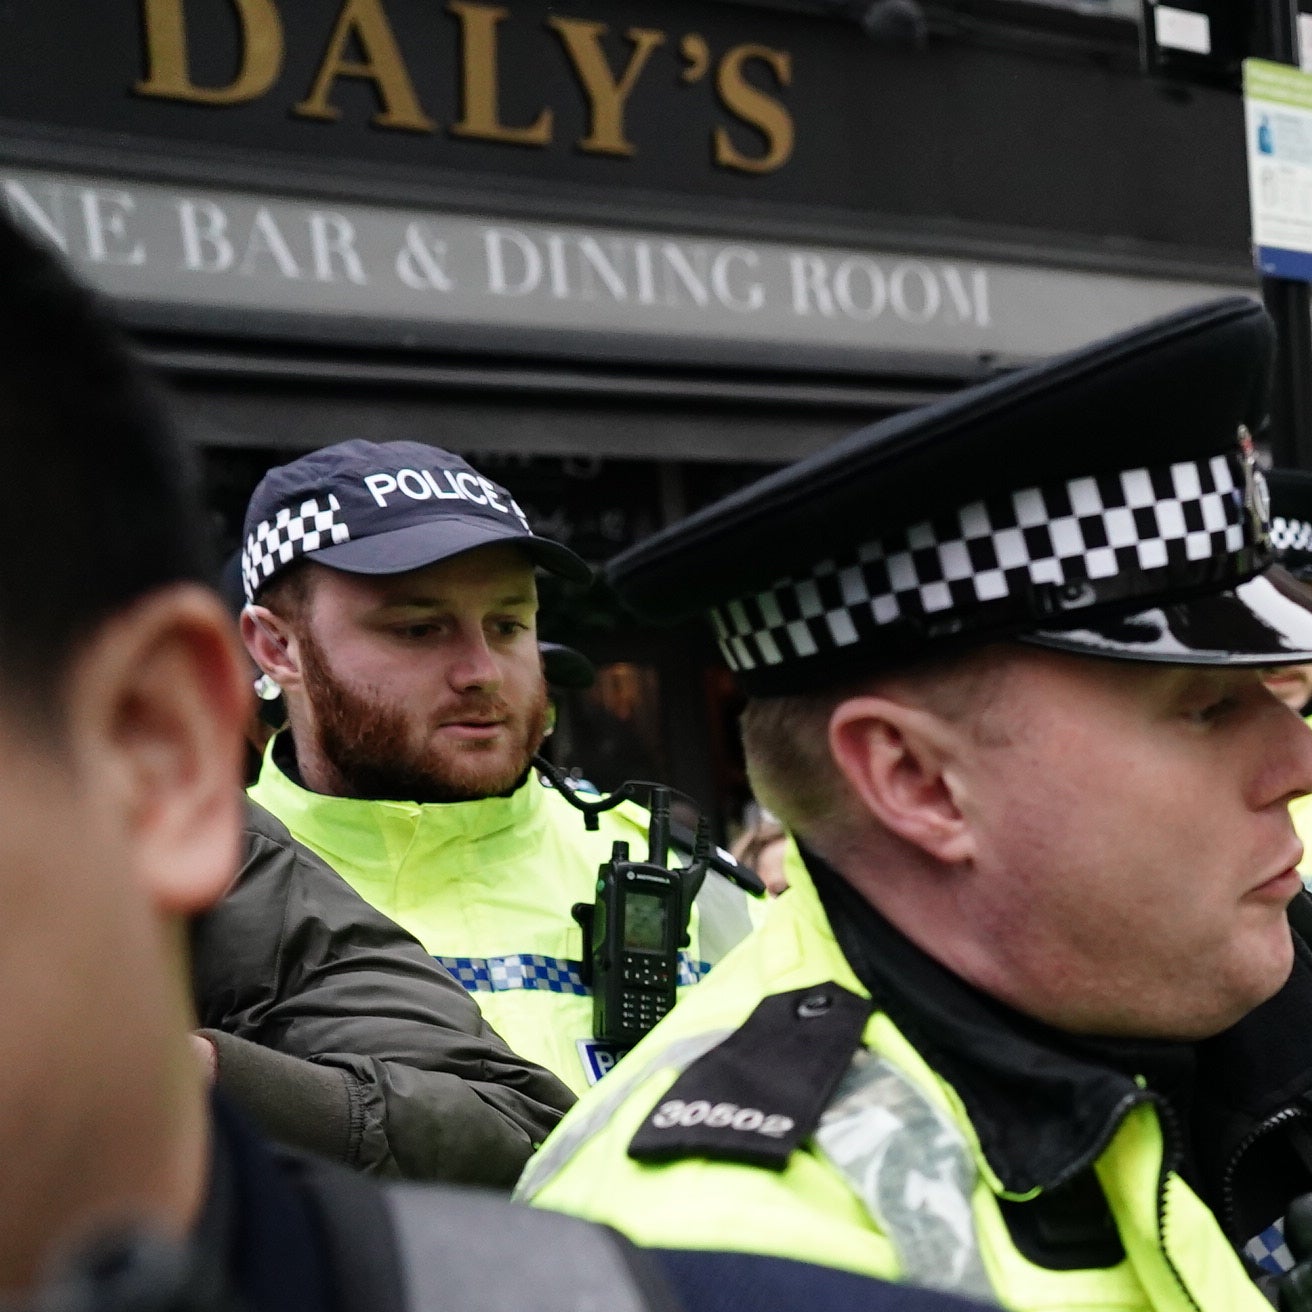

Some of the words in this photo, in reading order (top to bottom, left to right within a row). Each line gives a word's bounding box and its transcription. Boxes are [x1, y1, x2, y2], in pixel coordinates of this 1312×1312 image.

[132, 0, 796, 174] DALY'S
[176, 198, 368, 287] BAR
[396, 220, 456, 293] &
[482, 227, 766, 315] DINING
[788, 252, 992, 328] ROOM
[364, 468, 508, 513] POLICE
